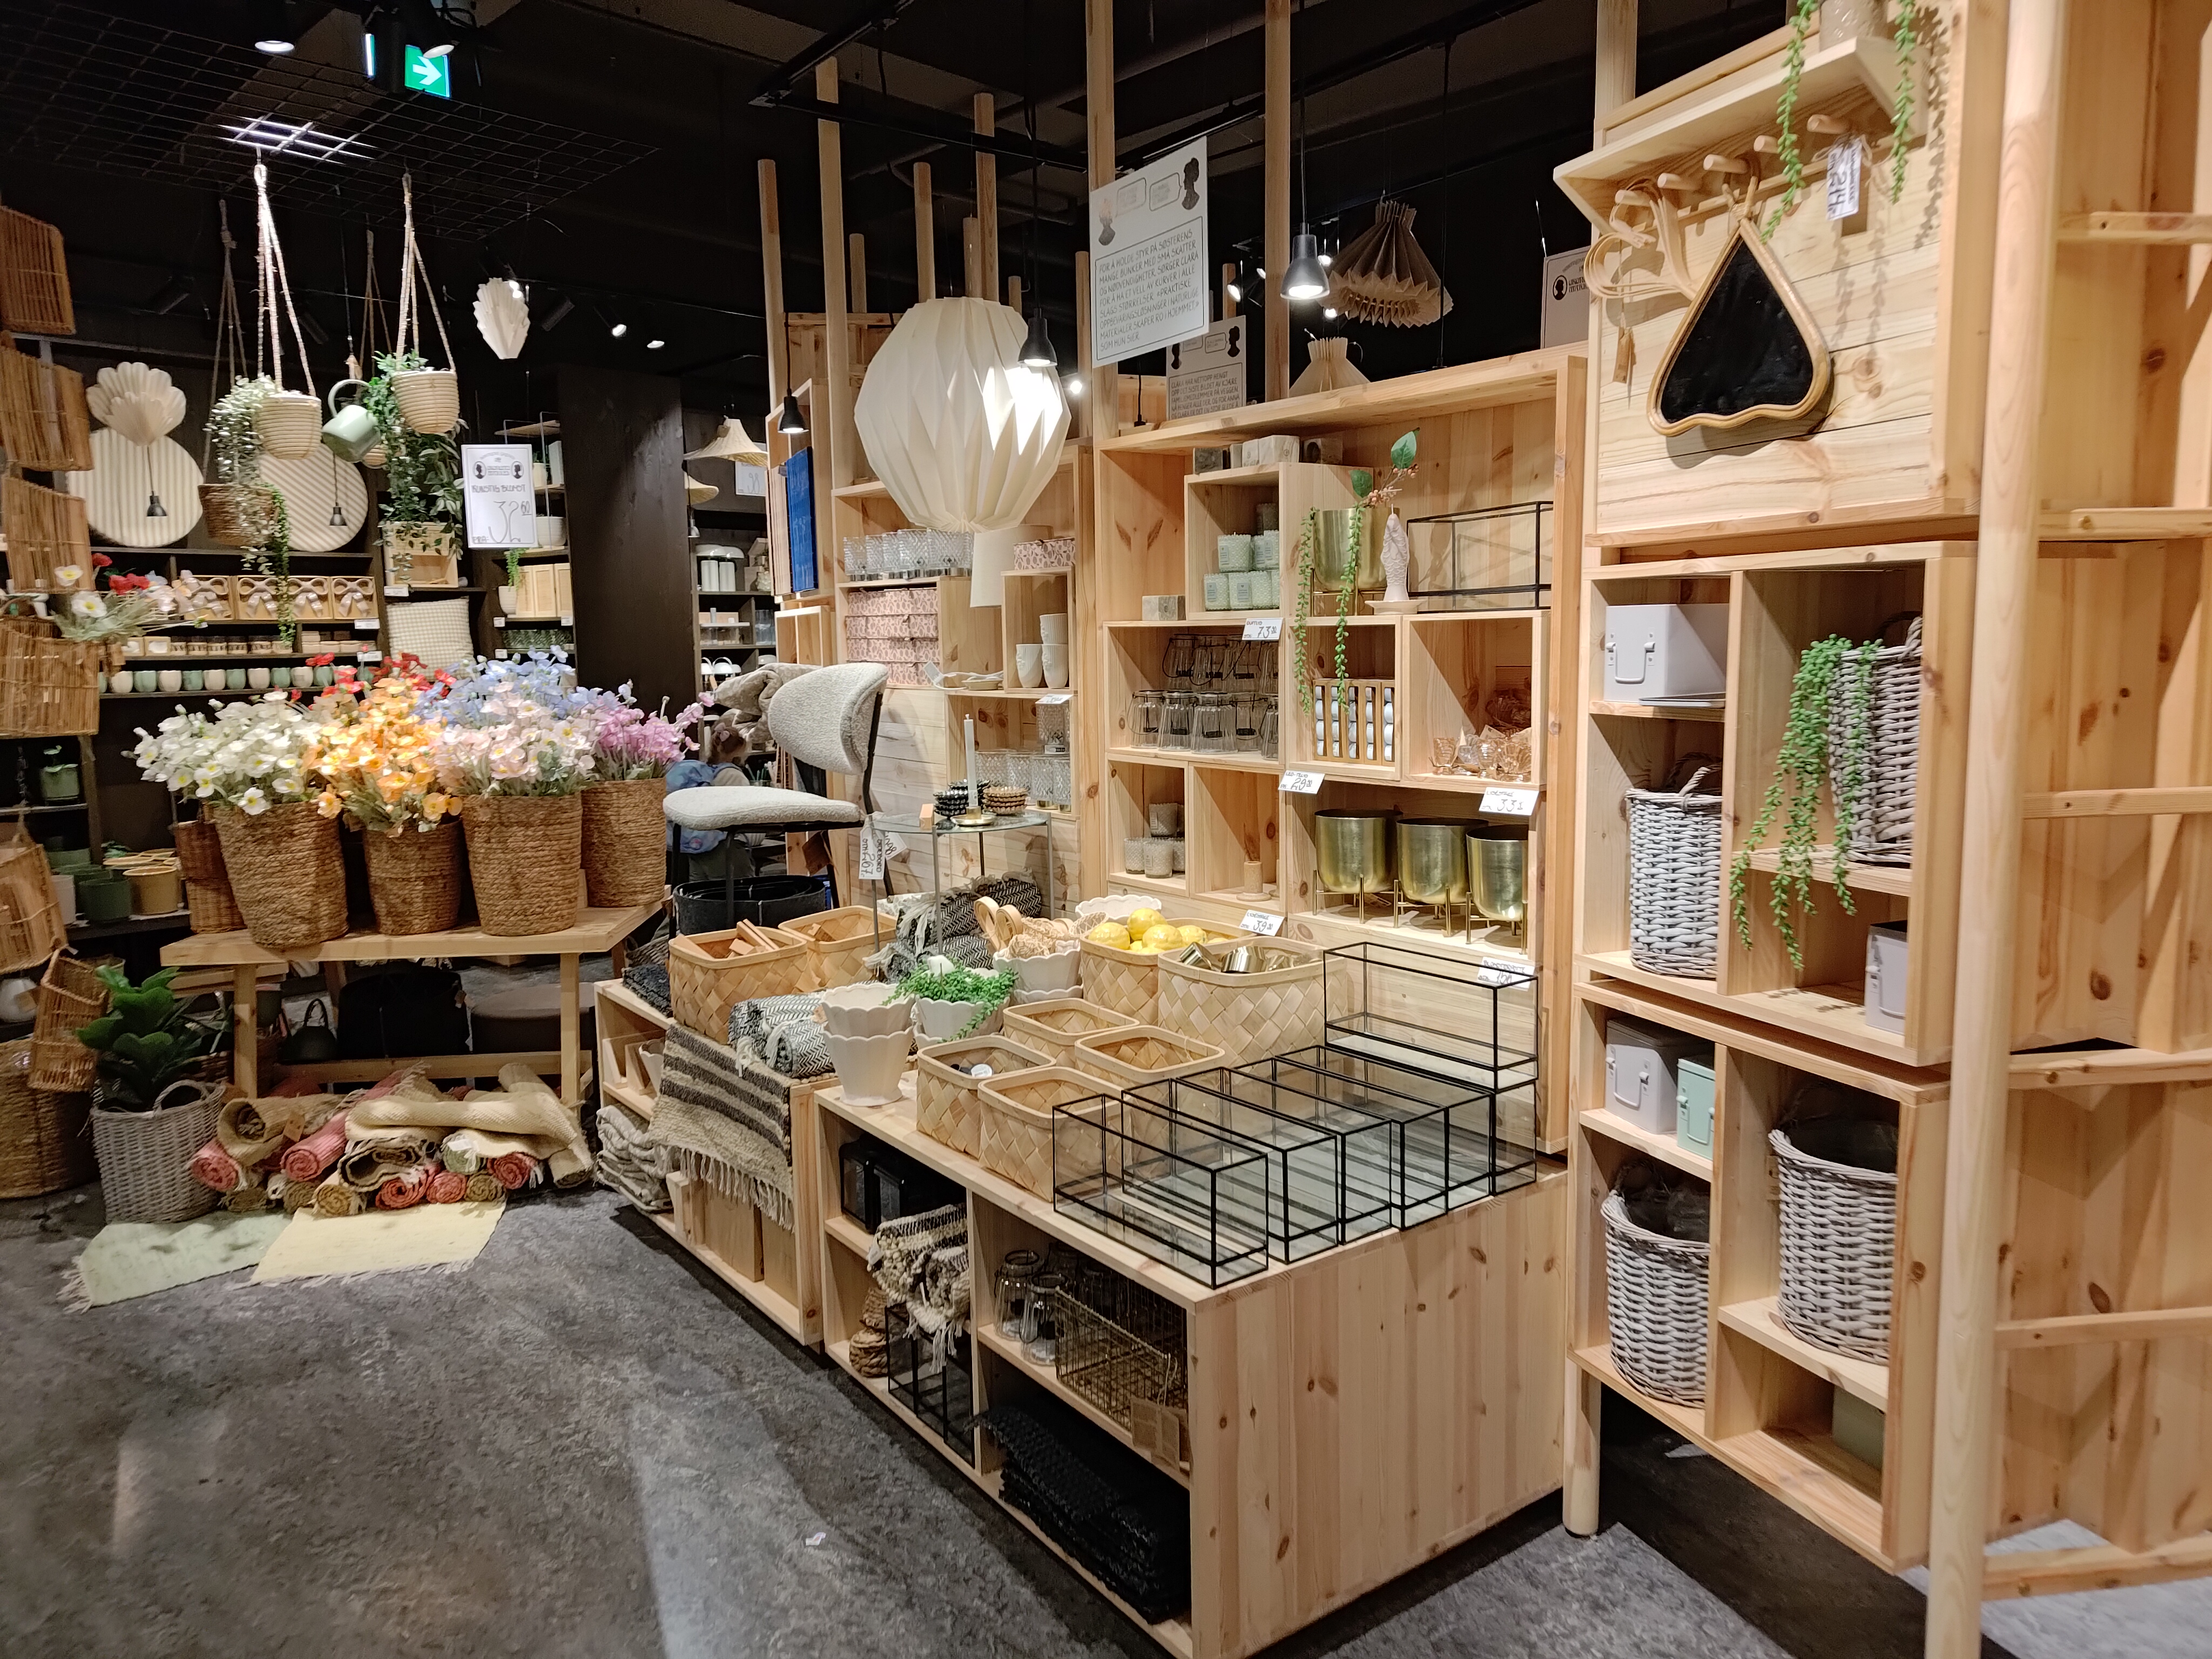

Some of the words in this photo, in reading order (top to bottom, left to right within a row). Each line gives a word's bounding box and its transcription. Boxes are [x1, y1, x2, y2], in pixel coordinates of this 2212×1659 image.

[1098, 262, 1110, 274] FOR
[1116, 254, 1135, 267] HOLDE
[1135, 247, 1149, 259] STYR
[1150, 242, 1158, 254] PÅ
[1158, 228, 1193, 251] SØSTERENS
[1099, 272, 1119, 285] MANGE
[1120, 261, 1143, 278] BUNKER
[1143, 258, 1156, 267] MED
[1157, 251, 1171, 260] SMÅ
[1170, 240, 1196, 258] SKATTER
[1099, 286, 1108, 296] OG
[1157, 259, 1180, 273] SØRGER
[1181, 251, 1199, 266] CLARA
[1099, 296, 1111, 307] FOR
[1116, 292, 1124, 301] HA
[1125, 288, 1132, 299] ET
[1132, 284, 1145, 295] VELL
[1155, 272, 1177, 287] KURVER
[1181, 267, 1196, 276] ALLE
[1100, 306, 1118, 319] SLAGS
[1170, 289, 1199, 305] NATURLIGE
[1100, 325, 1132, 340] MATERIALER
[1133, 315, 1155, 328] SKAPER
[1155, 313, 1163, 322] RO
[1100, 340, 1114, 352] SOM
[1114, 338, 1126, 347] HUN
